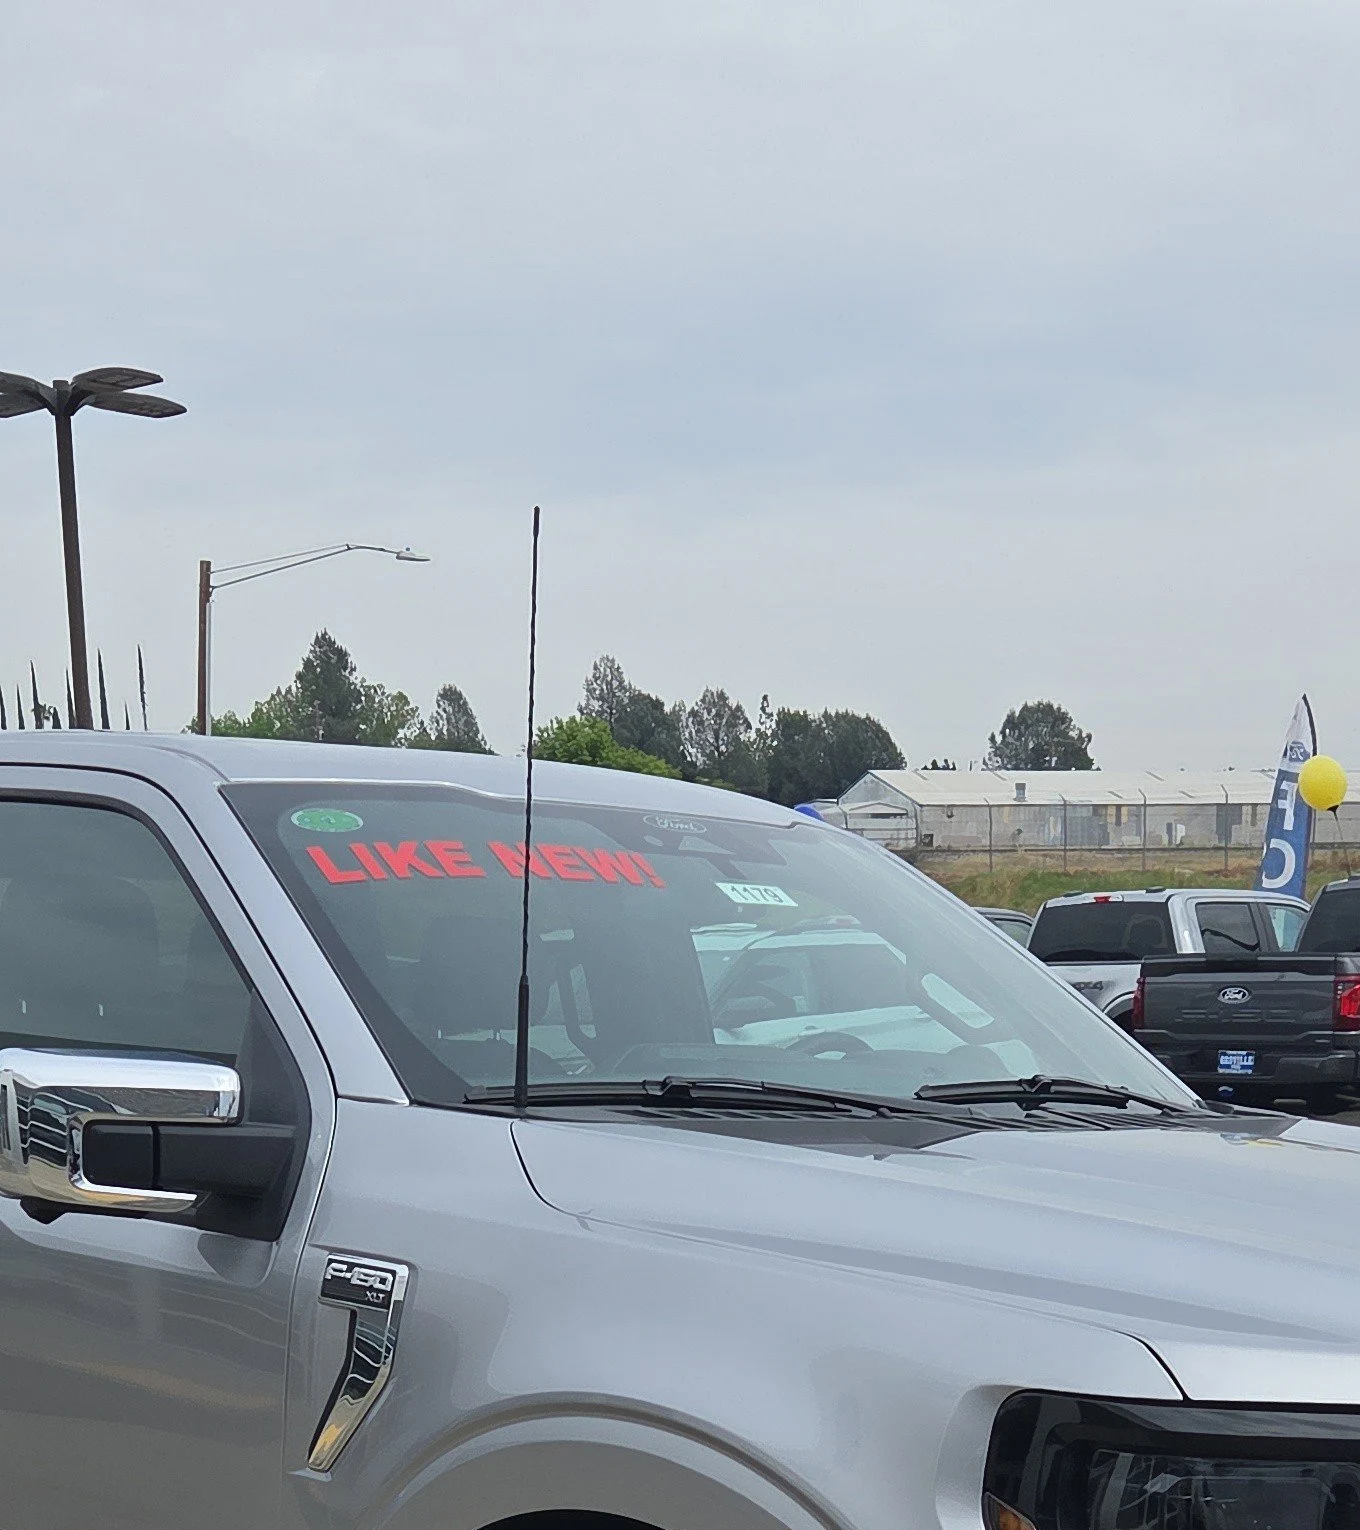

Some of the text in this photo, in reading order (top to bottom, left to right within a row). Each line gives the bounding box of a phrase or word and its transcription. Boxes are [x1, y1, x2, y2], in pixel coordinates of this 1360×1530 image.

[306, 840, 666, 889] LIKE NEW!
[731, 885, 784, 903] 1179
[366, 1290, 386, 1303] XLT
